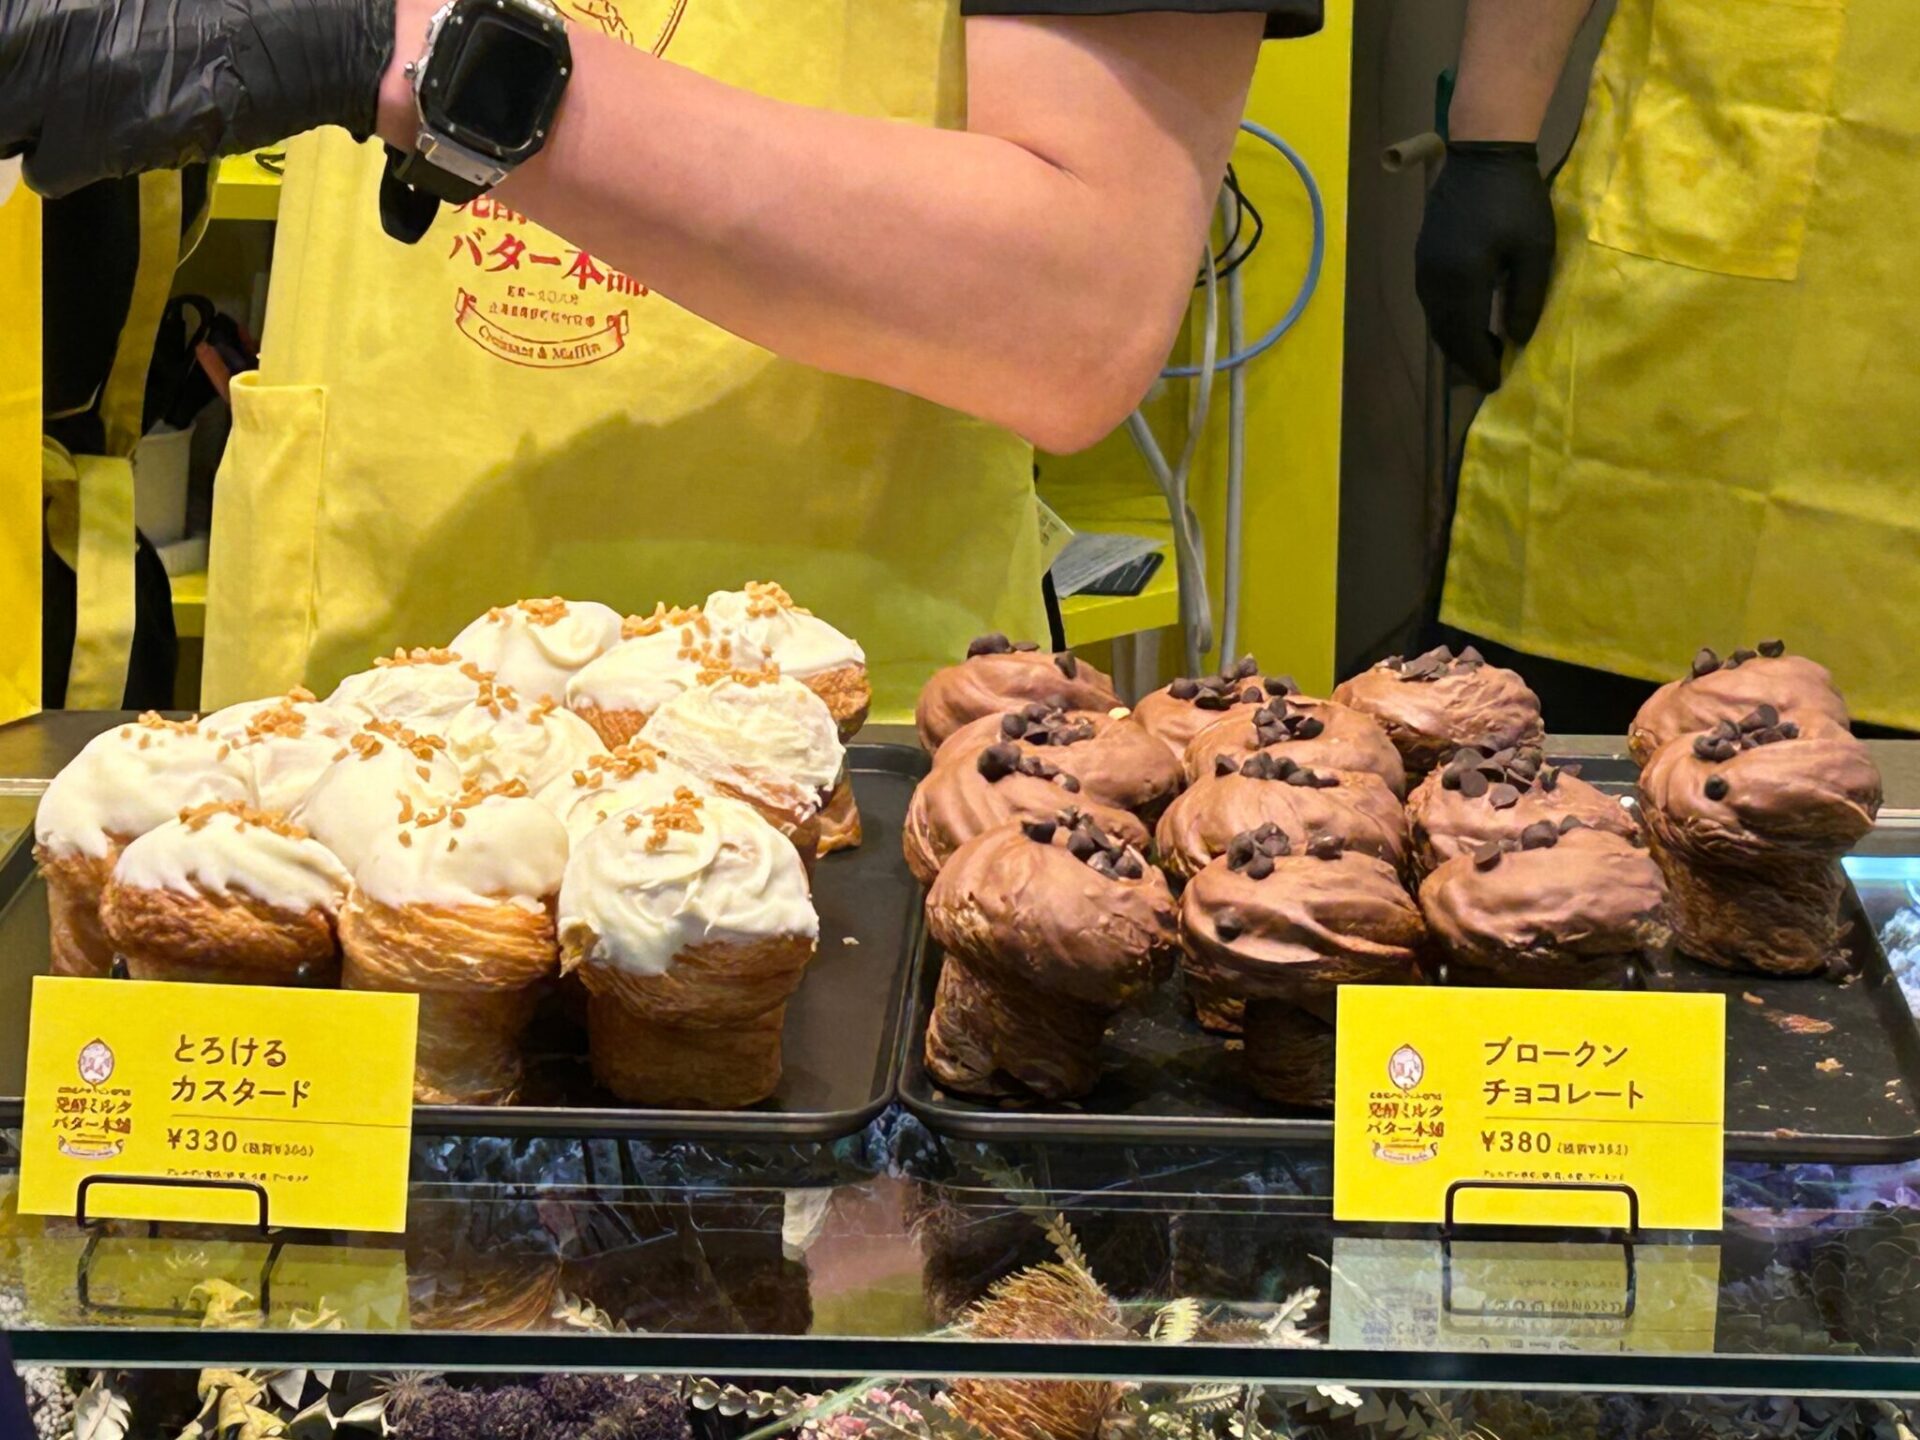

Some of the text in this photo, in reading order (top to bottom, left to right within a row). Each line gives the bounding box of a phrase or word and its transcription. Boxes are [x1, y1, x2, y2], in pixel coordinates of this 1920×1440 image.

[174, 1034, 287, 1067] とろける
[1484, 1036, 1628, 1068] ブロークン
[171, 1075, 311, 1108] カスタード
[1483, 1079, 1644, 1110] チョコレート
[167, 1128, 238, 1153] ¥330
[1481, 1131, 1552, 1154] ¥380
